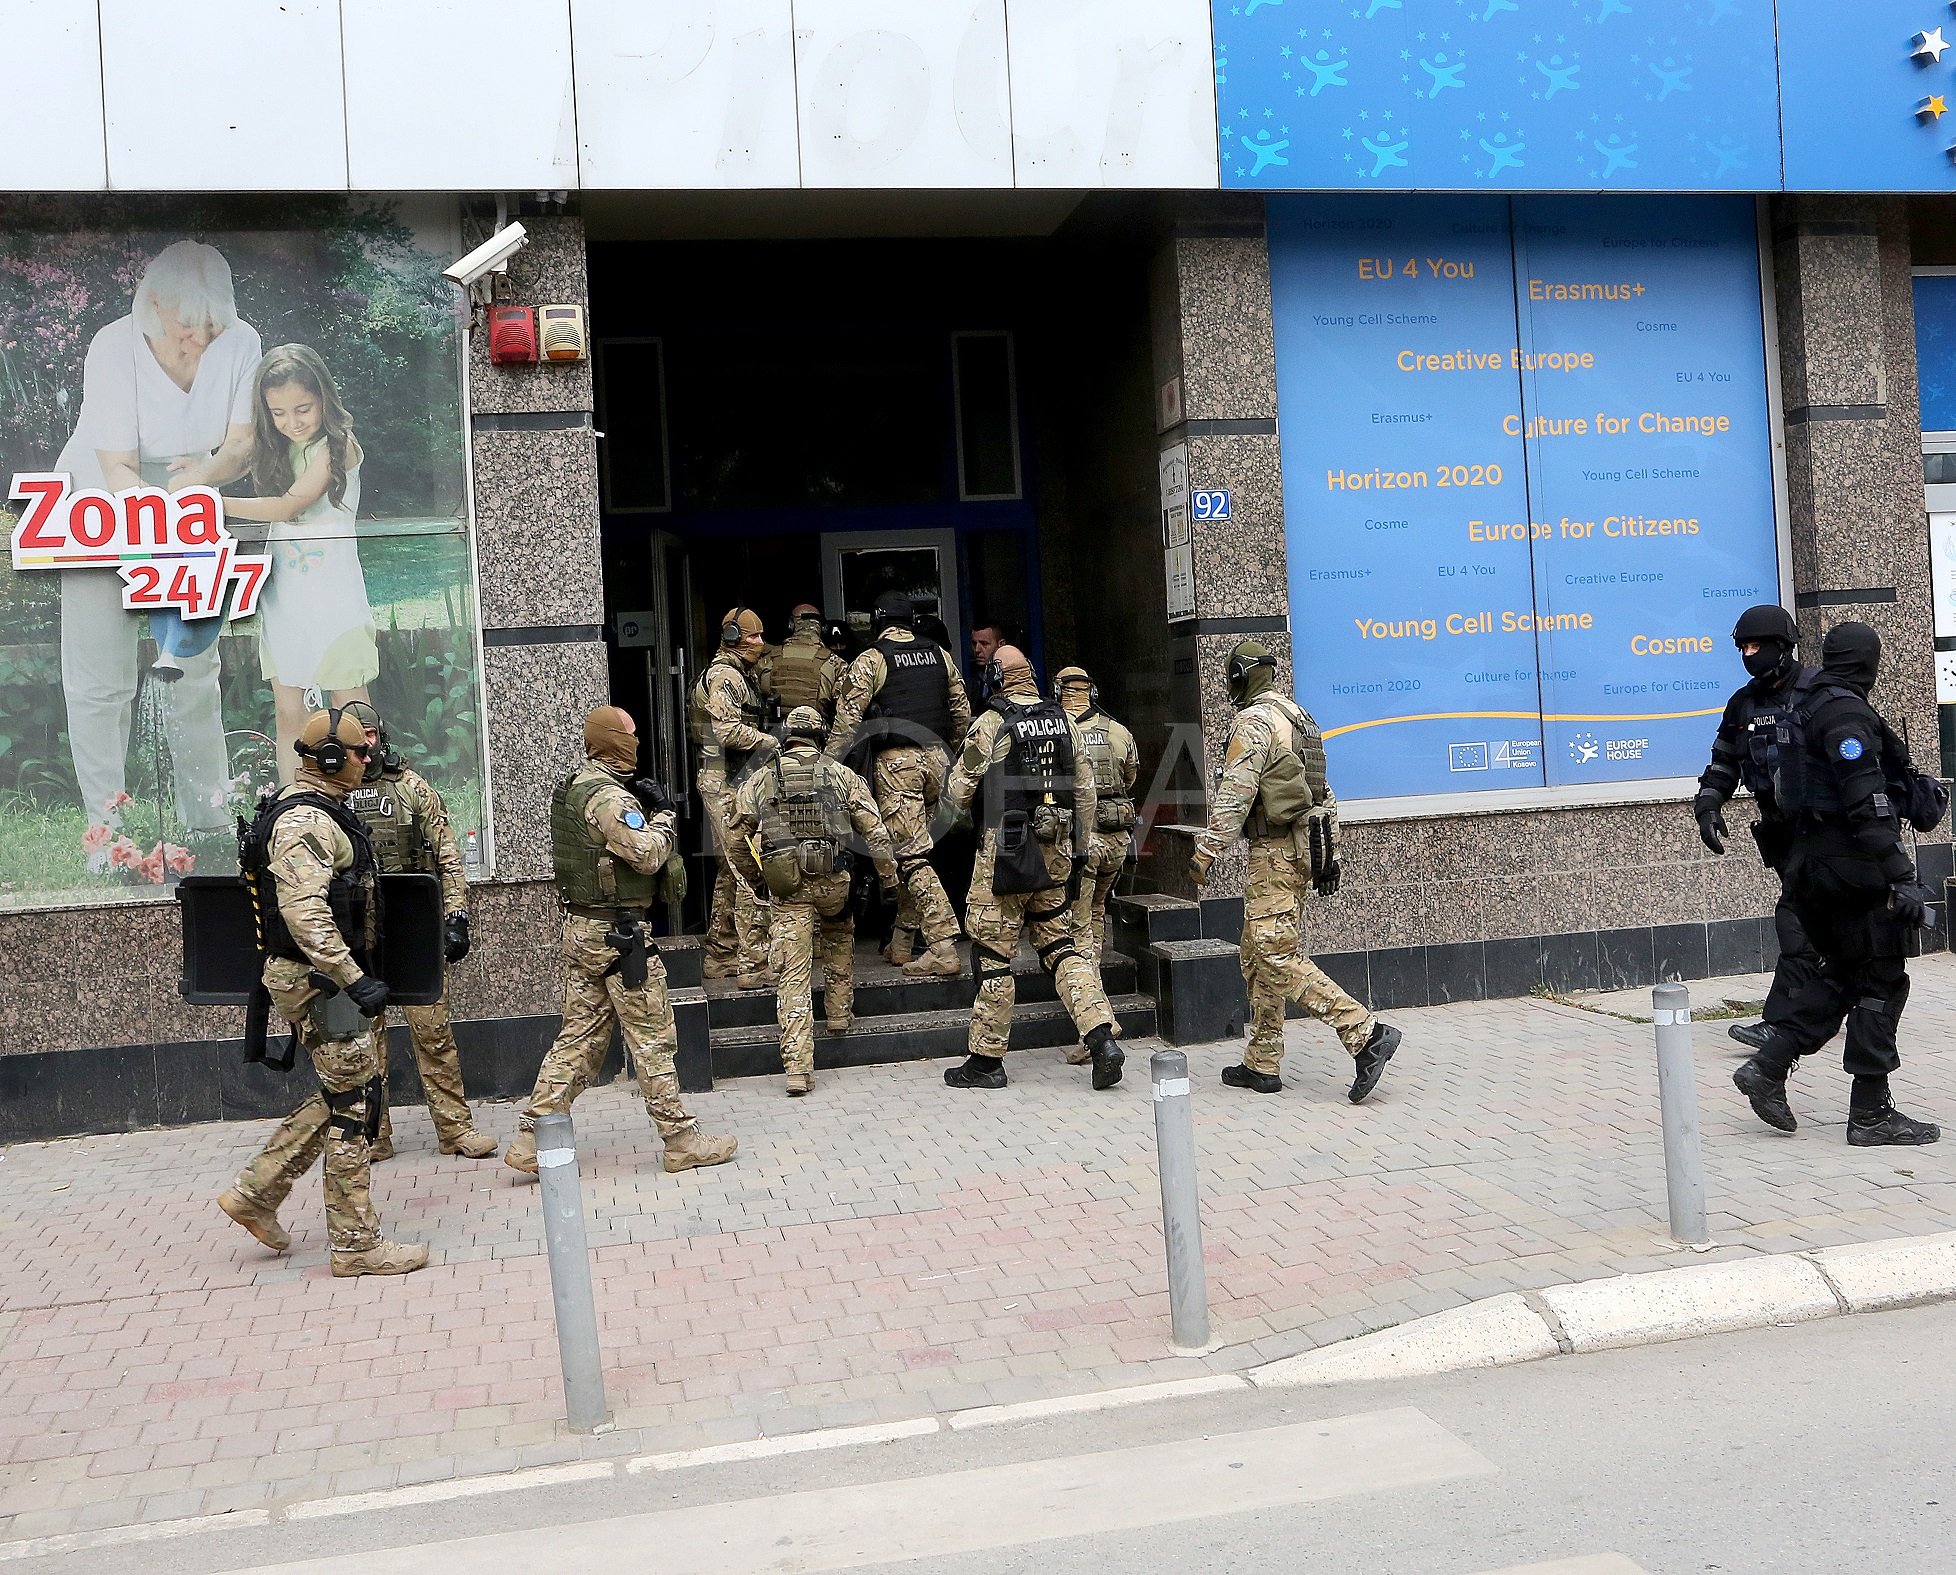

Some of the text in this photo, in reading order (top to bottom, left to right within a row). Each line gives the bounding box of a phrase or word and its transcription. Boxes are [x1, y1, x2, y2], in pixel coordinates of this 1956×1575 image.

[1303, 217, 1393, 231] Horizon 2020
[1603, 237, 1647, 249] Europe
[1358, 258, 1475, 280] EU 4 You
[1529, 279, 1646, 300] Erasmus+
[1313, 313, 1438, 327] Young Cell Scheme
[1636, 321, 1678, 332] Cosme
[1397, 348, 1595, 372] Creative Europe
[1676, 372, 1731, 383] EU 4 You
[1371, 413, 1433, 424] Erasmus+
[1502, 412, 1730, 438] Culture for Change
[1327, 464, 1503, 490] Horizon 2020
[1582, 467, 1700, 482] Young Cell Scheme
[1195, 491, 1228, 518] 92
[18, 480, 222, 549] Zona
[1364, 519, 1409, 531] Cosme
[1468, 515, 1699, 542] Europe for Citizens
[1309, 568, 1373, 581] Erasmus+
[1438, 564, 1496, 577] EU 4 You
[128, 547, 264, 613] 24/7
[1565, 572, 1664, 585] Creative Europe
[1702, 586, 1760, 598] Erasmus+
[1355, 610, 1593, 640] Young Cell Scheme
[1630, 634, 1713, 656] Cosme
[894, 651, 938, 668] POLICJA
[1464, 670, 1577, 683] Culture for hange
[1332, 679, 1421, 695] Horizon 2020
[1603, 679, 1720, 695] Europe for Citizens
[1016, 718, 1068, 738] POLICJA
[1512, 740, 1542, 748] European
[1606, 739, 1649, 750] EUROPE
[1607, 749, 1642, 760] HOUSE
[352, 788, 379, 800] OLICJA
